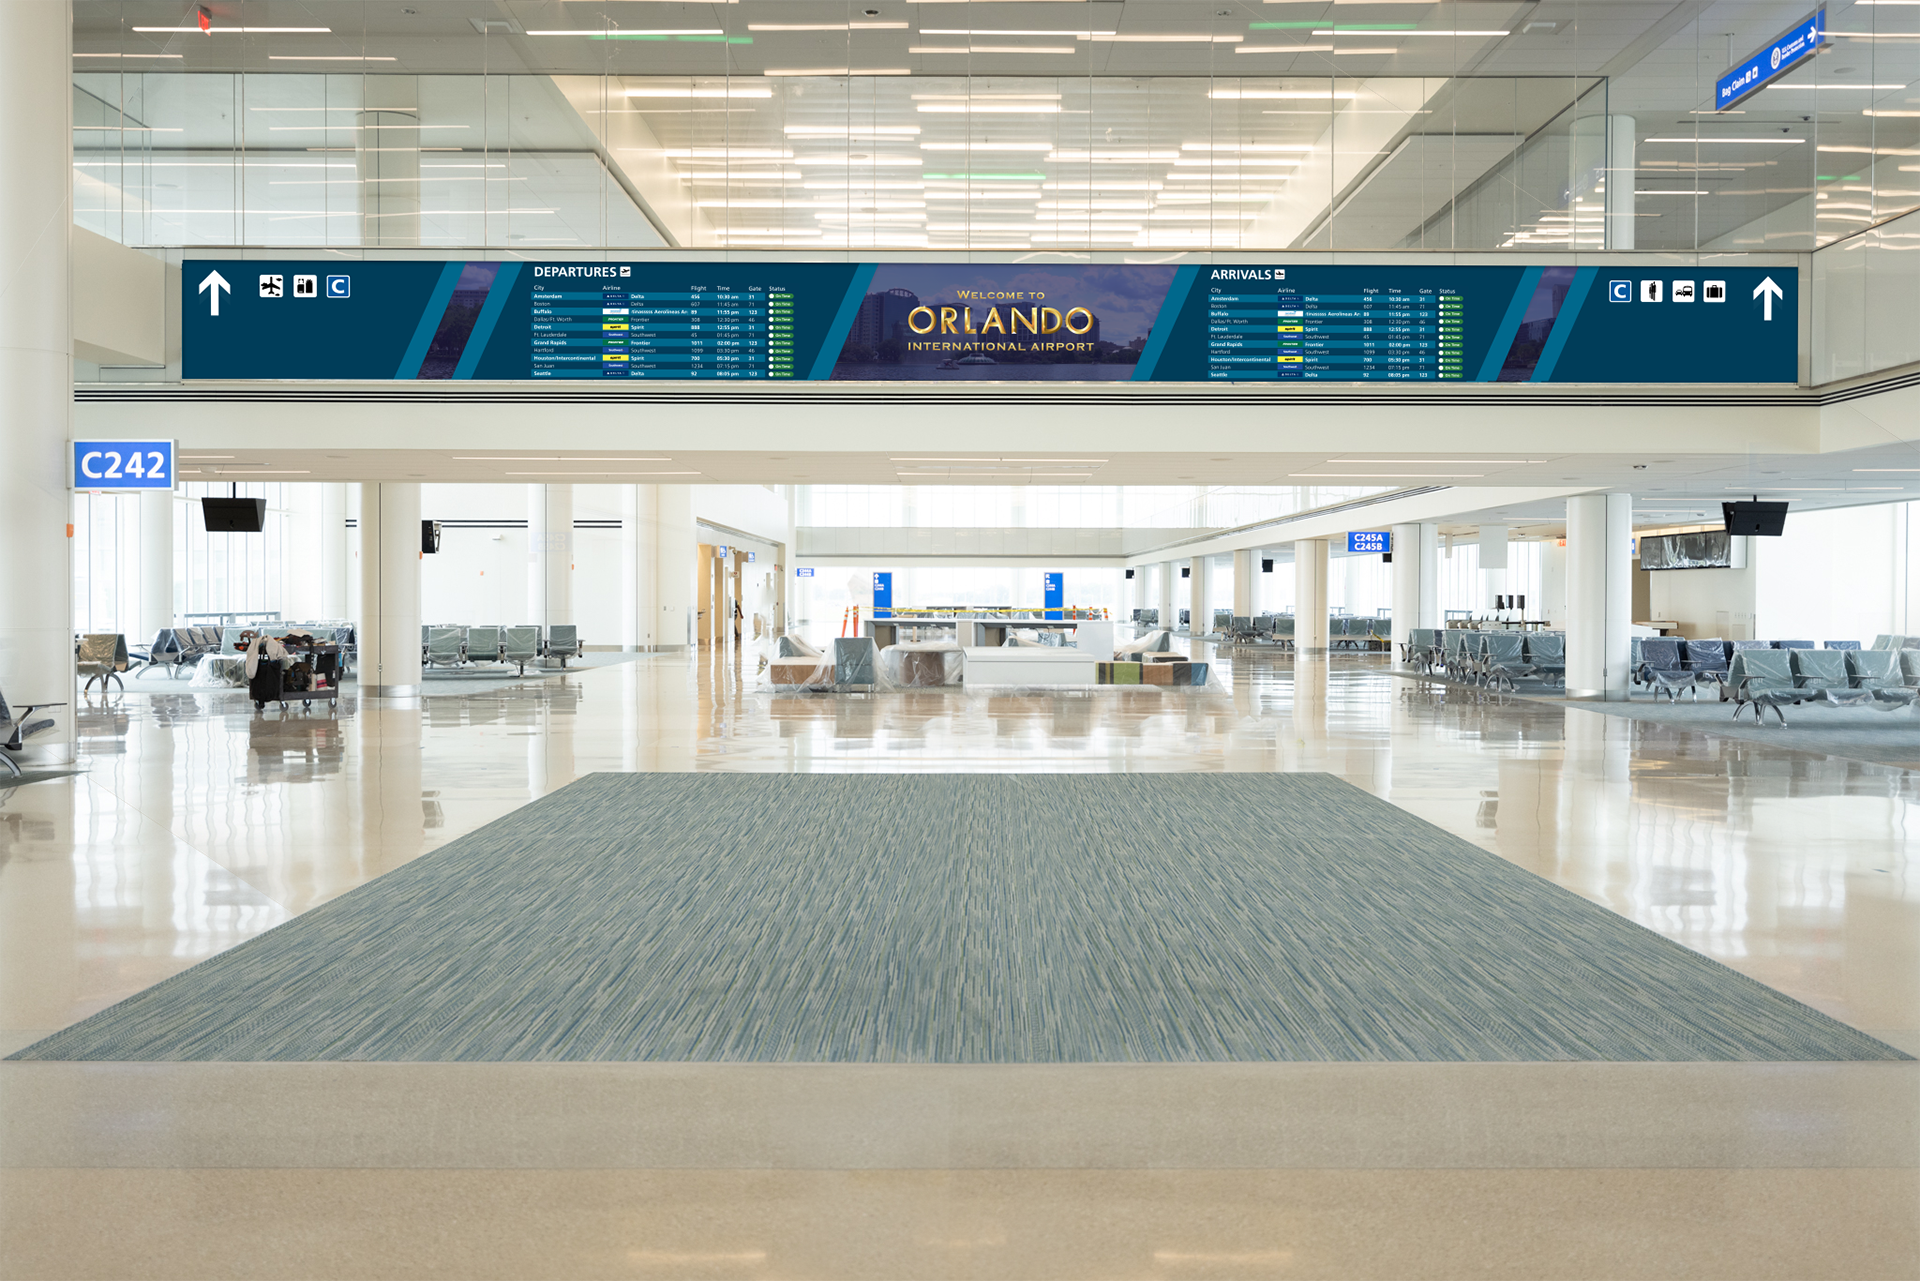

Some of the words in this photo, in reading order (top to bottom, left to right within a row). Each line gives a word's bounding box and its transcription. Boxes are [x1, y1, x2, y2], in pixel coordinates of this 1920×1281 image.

[1722, 85, 1731, 97] Bag
[1732, 77, 1745, 91] Claim
[534, 266, 617, 278] DEPARTURES
[1210, 269, 1272, 280] ARRIVALS
[331, 279, 346, 295] C
[1613, 284, 1627, 299] C
[957, 290, 1024, 300] WELCOME
[1029, 291, 1046, 300] TO
[907, 306, 1095, 335] ORLANDO
[908, 341, 1026, 352] INTERNATIONAL
[1030, 341, 1095, 352] AIRPORT
[81, 451, 165, 479] C242
[1354, 533, 1384, 542] C245A
[1354, 542, 1383, 551] C245B
